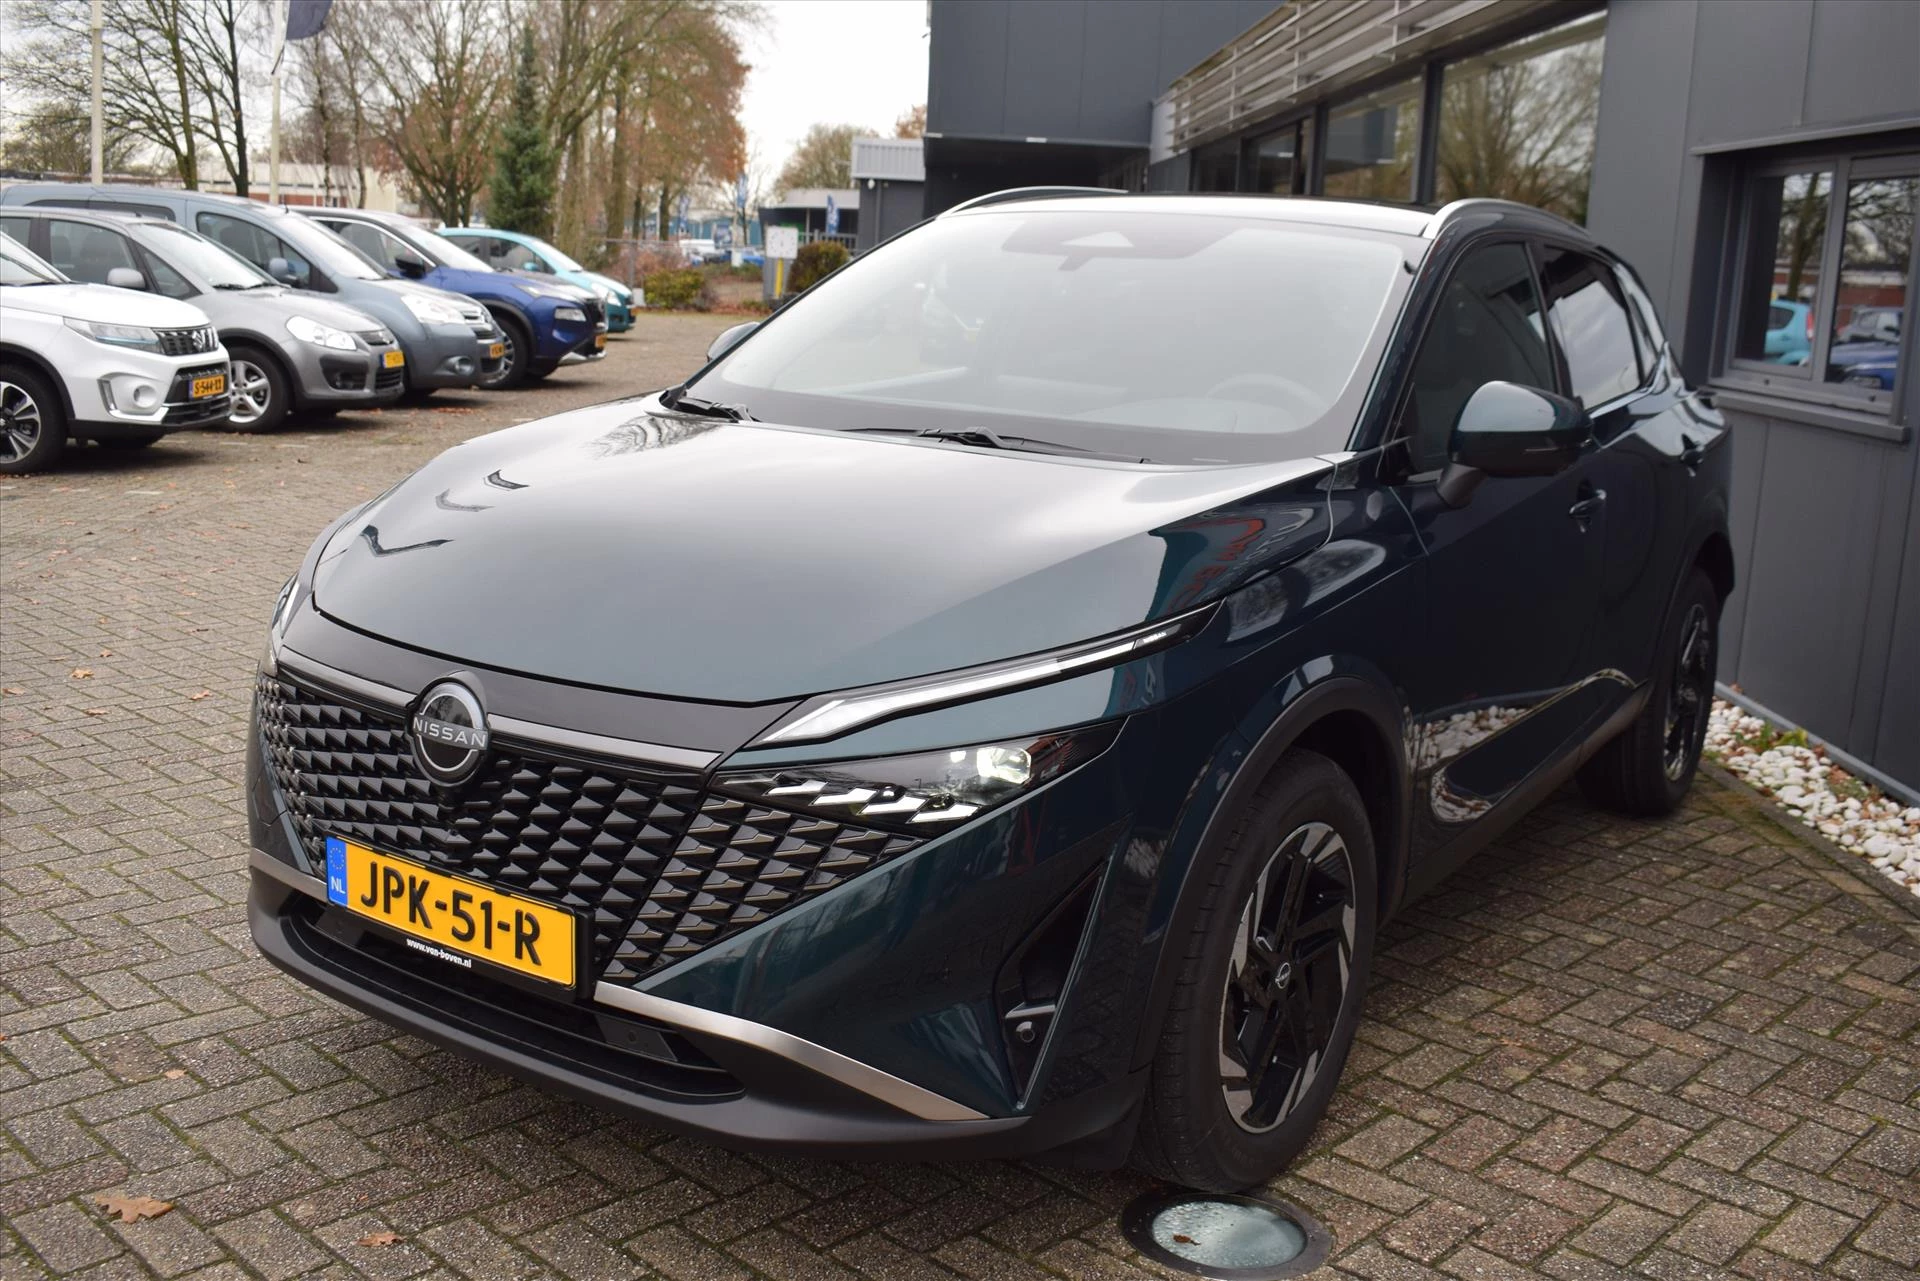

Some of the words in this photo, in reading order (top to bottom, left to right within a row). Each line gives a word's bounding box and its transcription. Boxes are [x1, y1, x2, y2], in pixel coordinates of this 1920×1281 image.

[413, 716, 486, 747] NISSAN
[330, 875, 346, 894] NL
[361, 861, 542, 966] JPK-51-R
[406, 938, 472, 968] www.van-boven.nl
